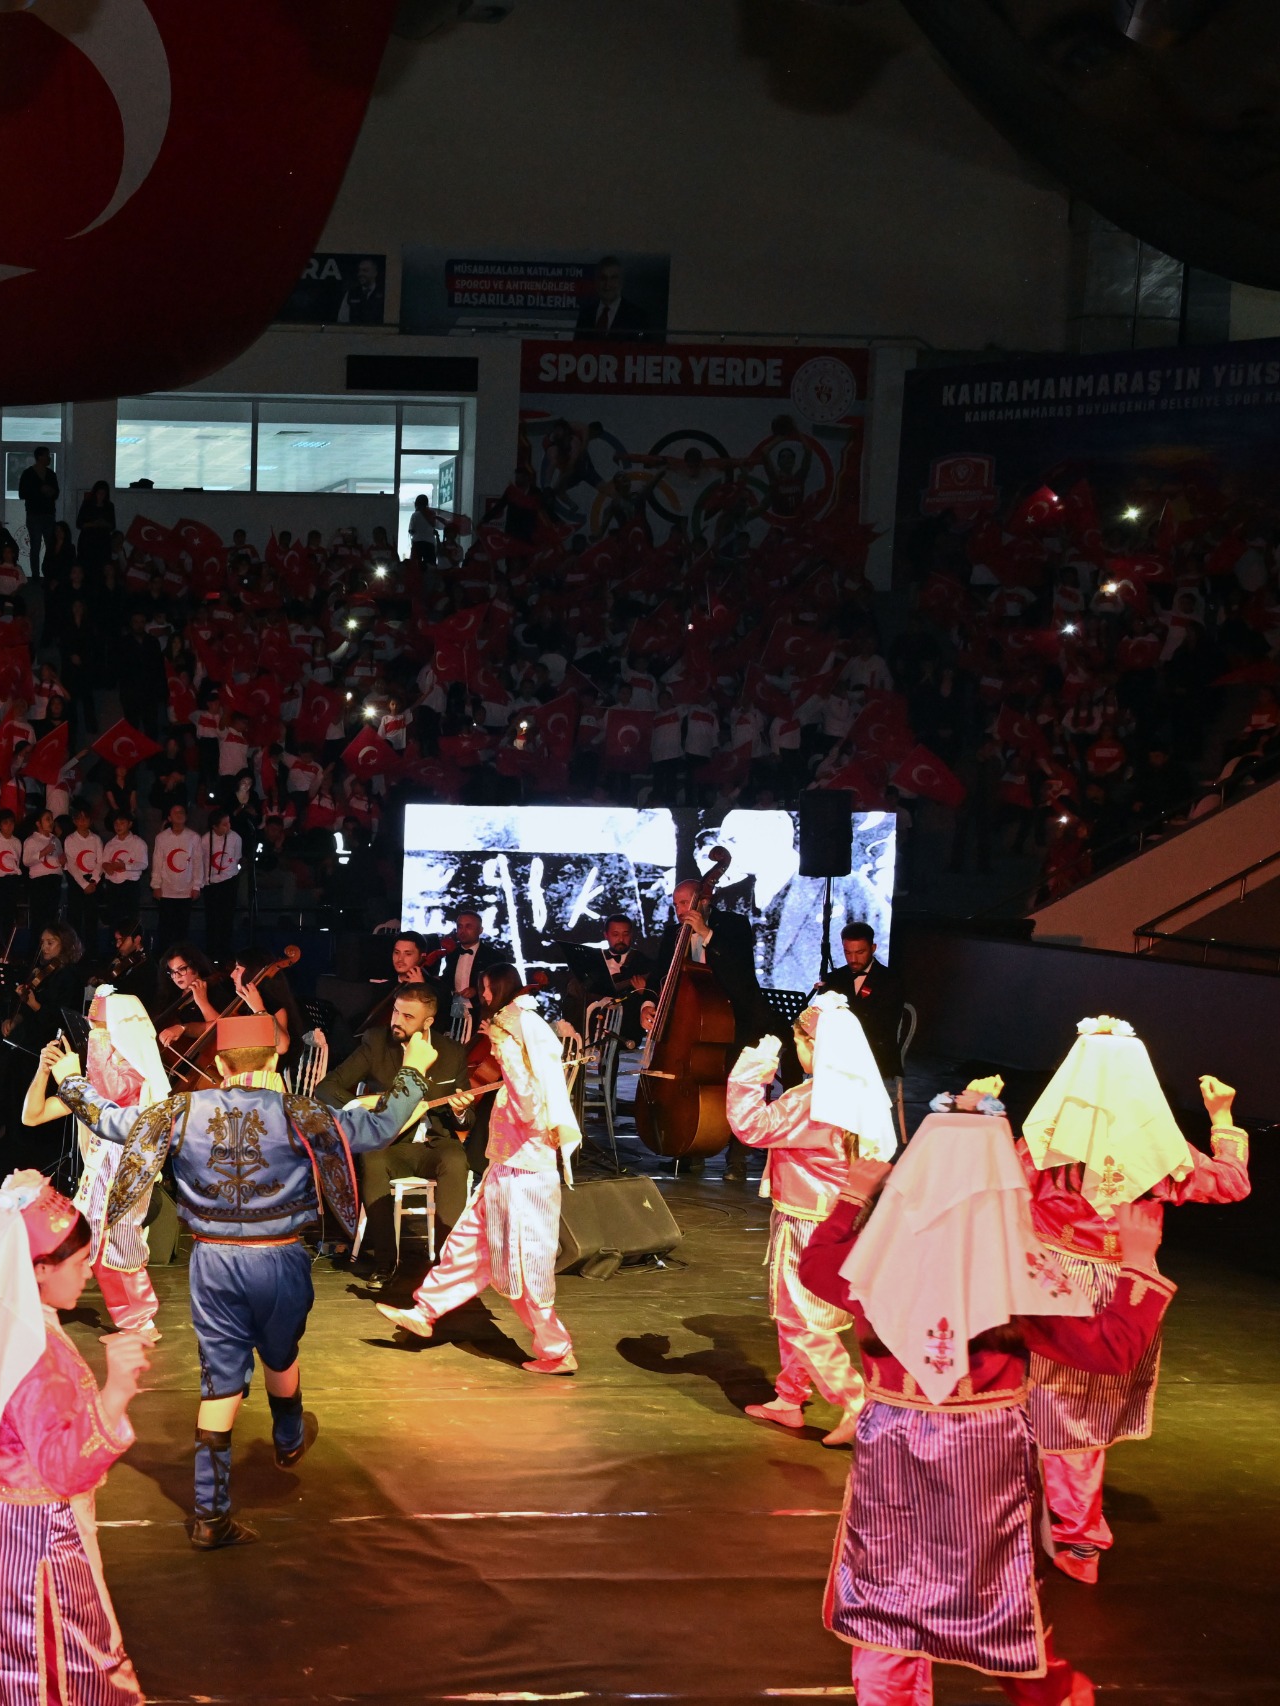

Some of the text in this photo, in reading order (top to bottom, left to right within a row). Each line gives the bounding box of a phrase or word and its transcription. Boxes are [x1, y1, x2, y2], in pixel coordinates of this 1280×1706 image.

[453, 263, 583, 278] MÜSABAKALARA KATILAN TÜM
[455, 279, 576, 292] SPORCU VE ANTRENÖRLERE
[453, 292, 524, 307] BAŞARILAR
[538, 353, 784, 387] SPOR HER YERDE
[942, 366, 1201, 406] KAHRAMANMARAŞ'IN
